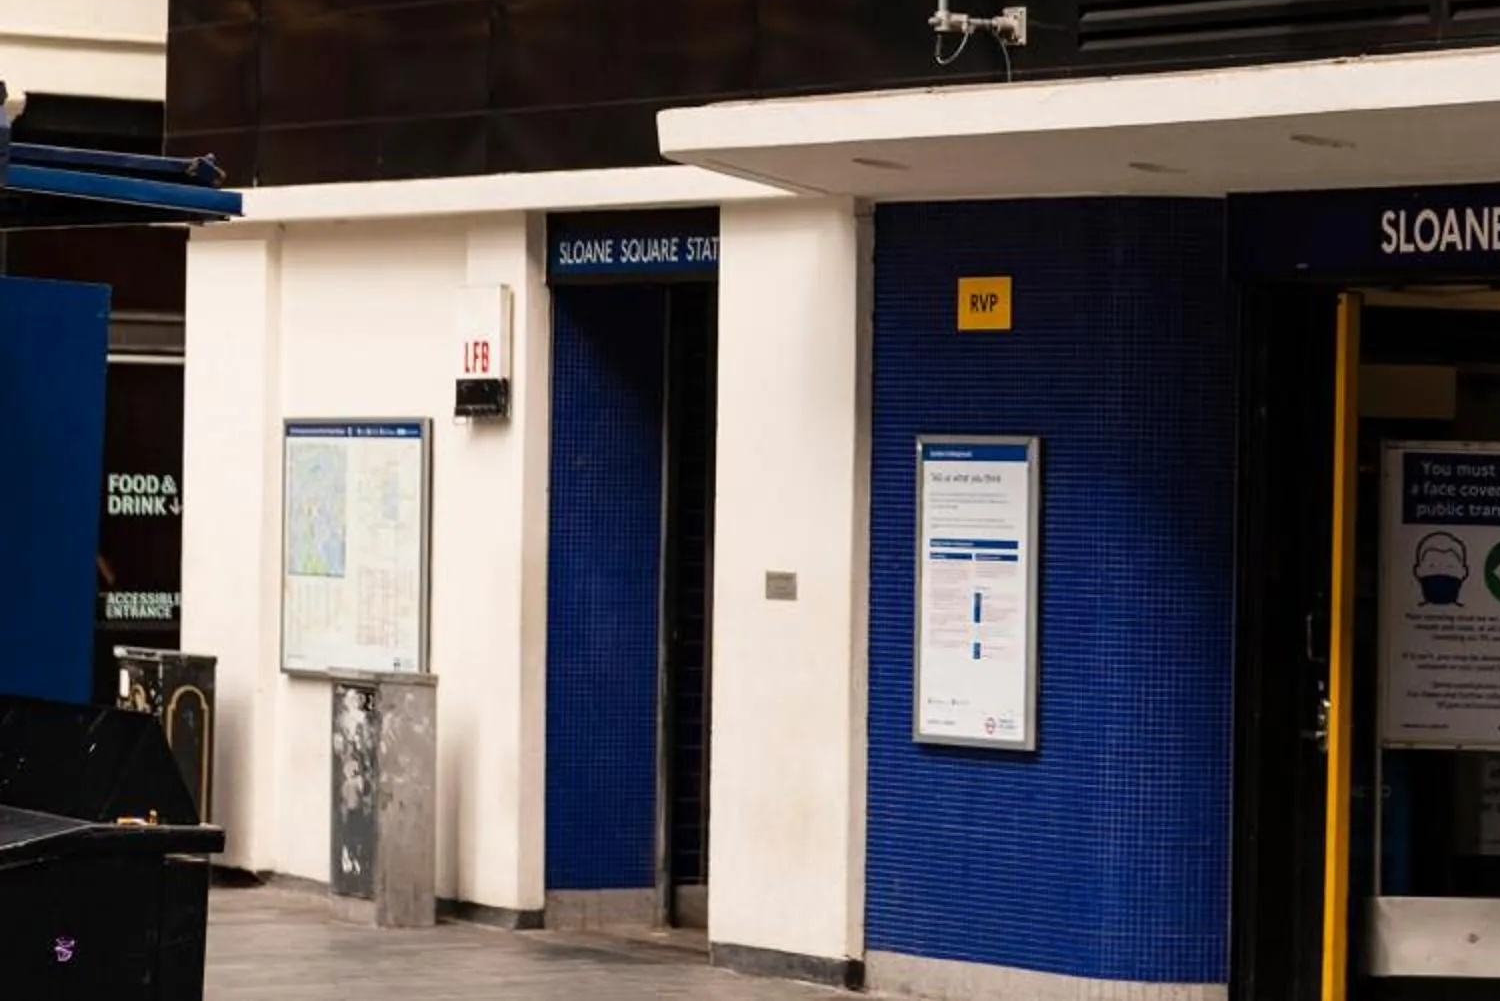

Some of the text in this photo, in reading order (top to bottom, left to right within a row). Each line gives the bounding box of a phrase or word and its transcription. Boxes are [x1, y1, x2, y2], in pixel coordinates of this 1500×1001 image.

[559, 239, 614, 265] SLOANE
[619, 237, 679, 264] SQUARE
[970, 293, 999, 313] RVP
[464, 341, 490, 374] LFB
[1422, 462, 1452, 477] You
[1457, 463, 1497, 478] must
[108, 474, 177, 495] FOOD &
[1422, 480, 1456, 496] face
[108, 495, 167, 515] DRINK
[1415, 501, 1465, 518] public
[105, 604, 172, 619] ENTRANCE
